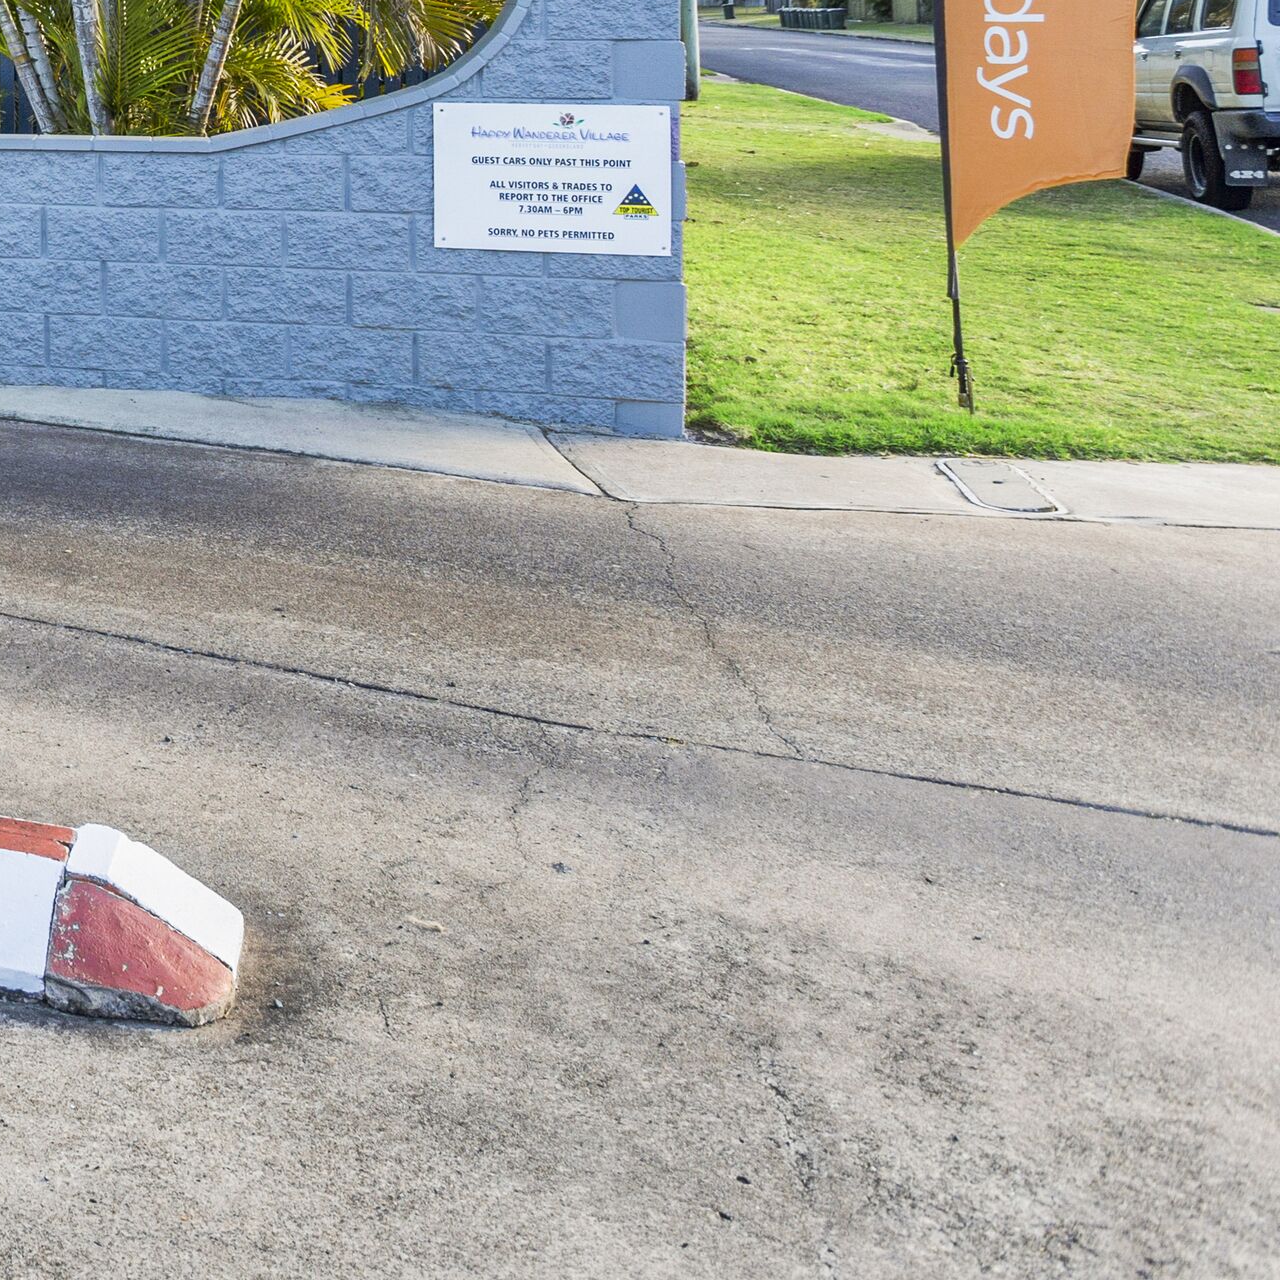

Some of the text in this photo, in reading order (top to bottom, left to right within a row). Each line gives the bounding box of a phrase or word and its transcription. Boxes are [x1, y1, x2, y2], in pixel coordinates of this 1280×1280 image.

[471, 155, 632, 168] GUEST CARS ONLY PAST THIS POINT
[489, 180, 613, 192] ALL VISITORS & TRADES TO
[499, 192, 603, 204] REPORT TO THE OFFICE
[519, 204, 553, 214] 7.30AM
[563, 206, 583, 215] 6PM
[488, 227, 615, 240] SORRY, NO PETS PERMITTED
